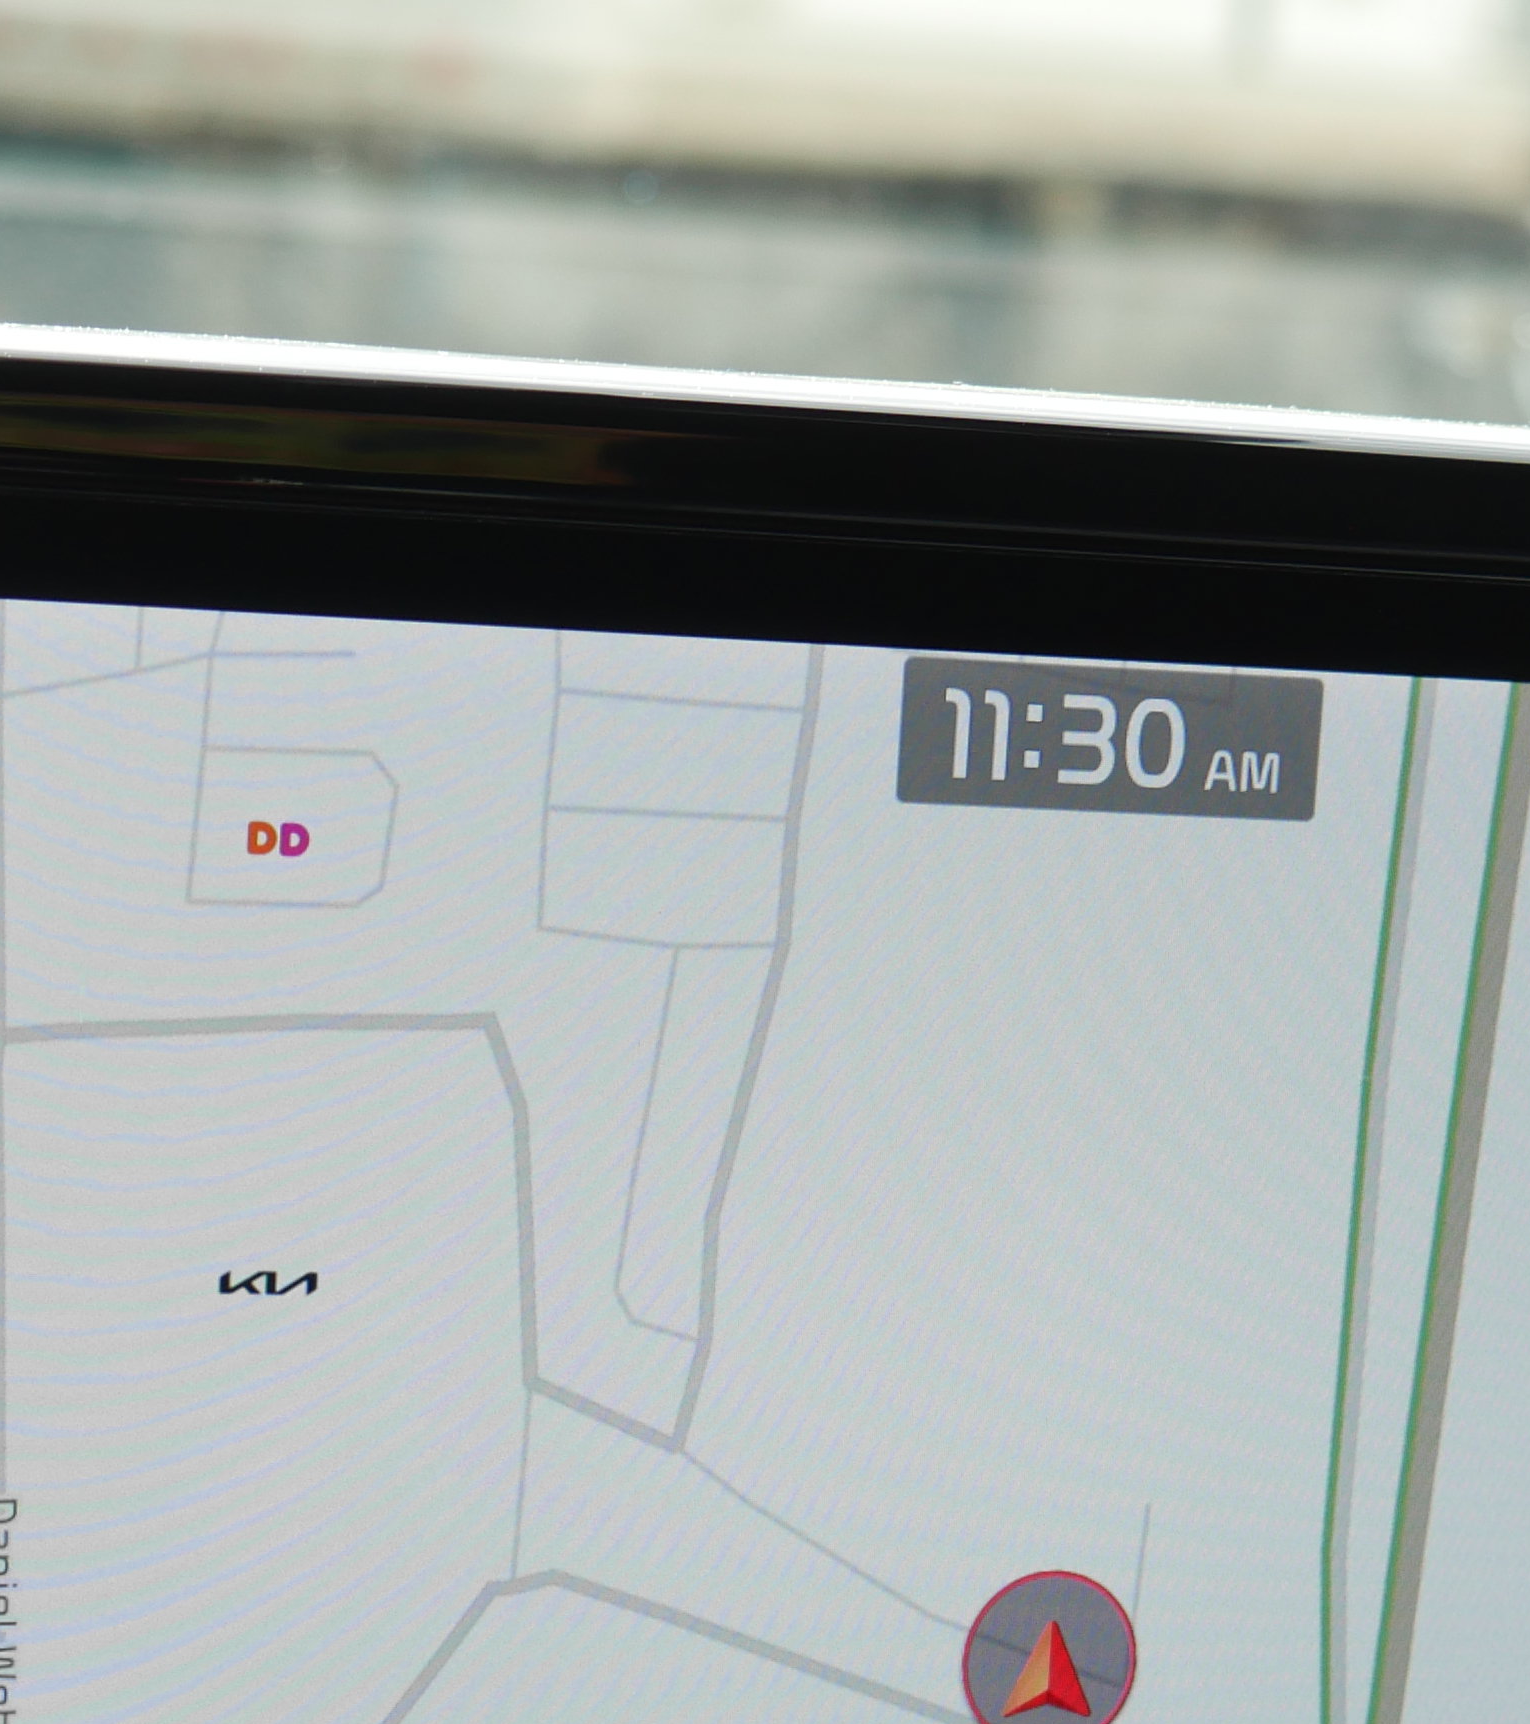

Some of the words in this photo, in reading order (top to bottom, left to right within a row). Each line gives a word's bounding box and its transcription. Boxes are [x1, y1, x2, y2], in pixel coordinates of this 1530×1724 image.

[944, 686, 1188, 789] 11:30
[1202, 748, 1280, 795] AM
[246, 821, 310, 857] DD
